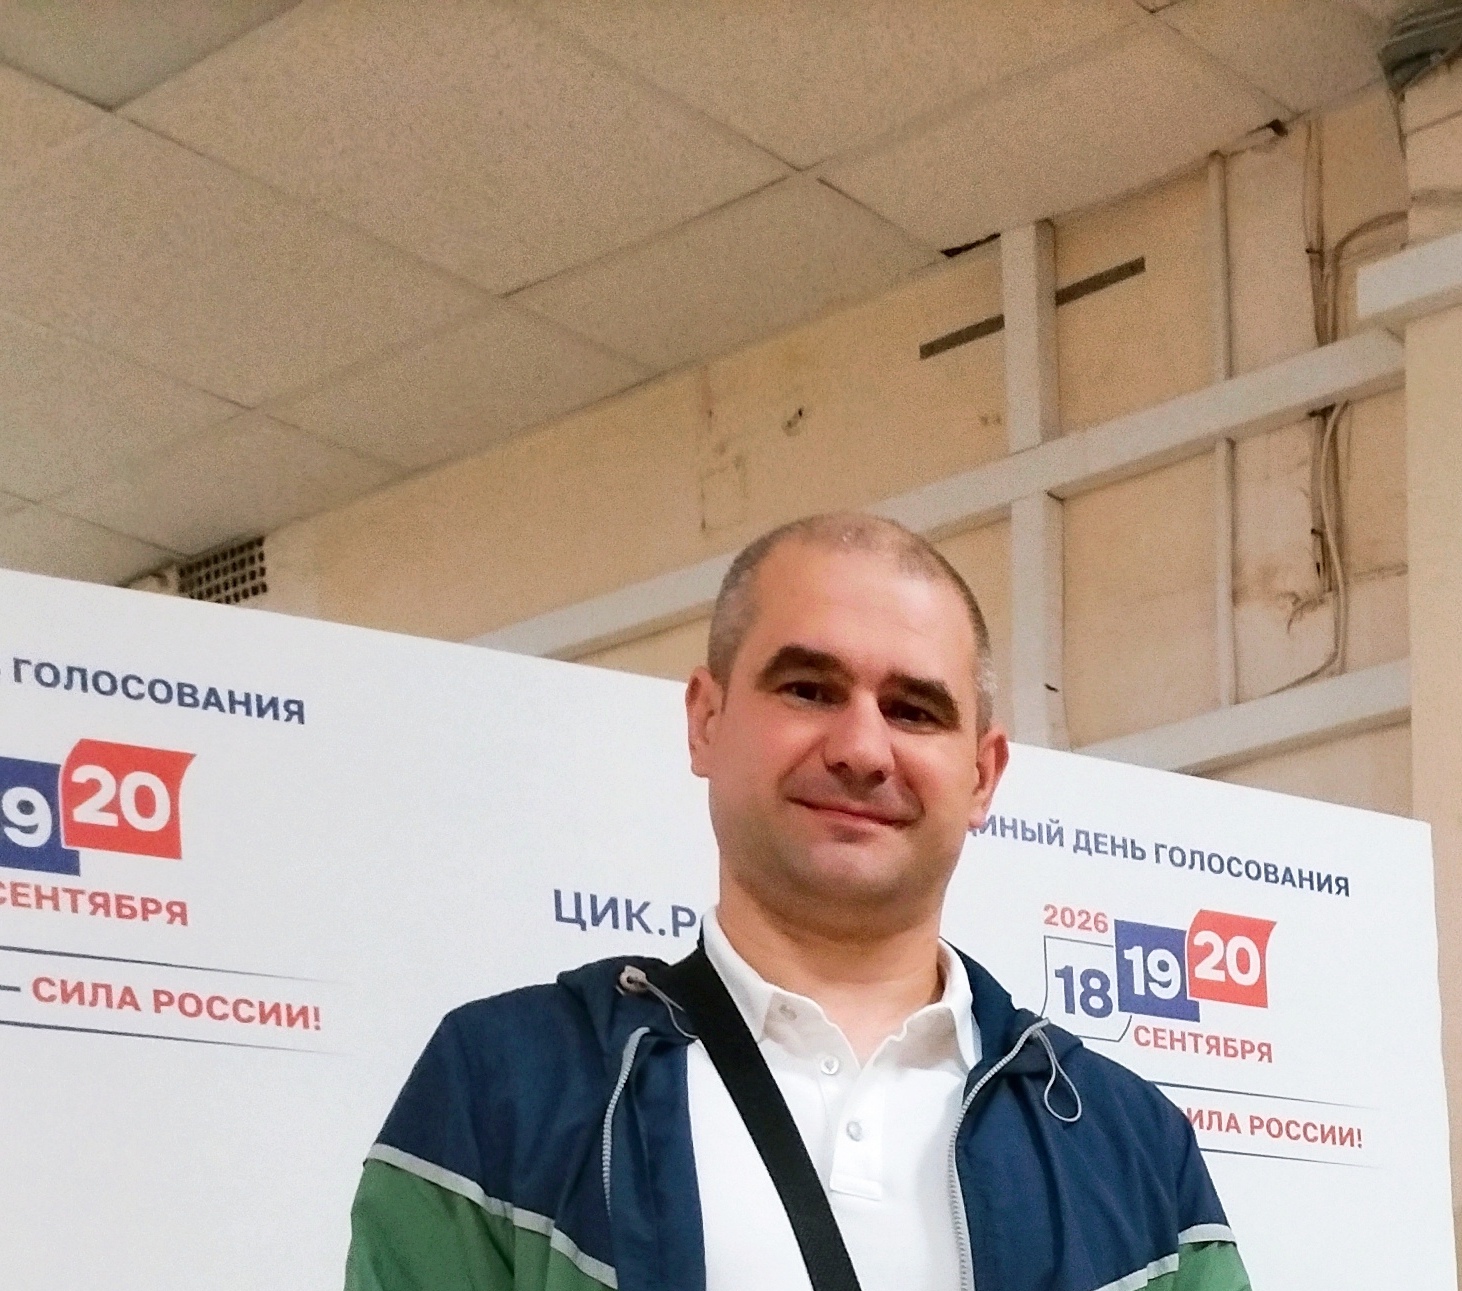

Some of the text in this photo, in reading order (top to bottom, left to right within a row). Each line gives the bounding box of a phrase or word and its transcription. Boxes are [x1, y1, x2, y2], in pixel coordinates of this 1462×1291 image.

[13, 657, 306, 725] ГОЛОСОВАНИЯ
[0, 764, 171, 848] 9 20
[968, 814, 1351, 898] ИНЫЙ ДЕНЬ ГОЛОСОВАНИЯ
[554, 889, 697, 938] ЦИК.Р
[1043, 903, 1109, 934] 2026
[1054, 930, 1261, 1019] 18 19 20
[32, 976, 141, 1014] СИЛА
[154, 989, 321, 1032] РОССИИ!
[1134, 1025, 1273, 1063] СЕНТЯБРЯ
[1186, 1107, 1363, 1148] ИЛА РОССИИ!
